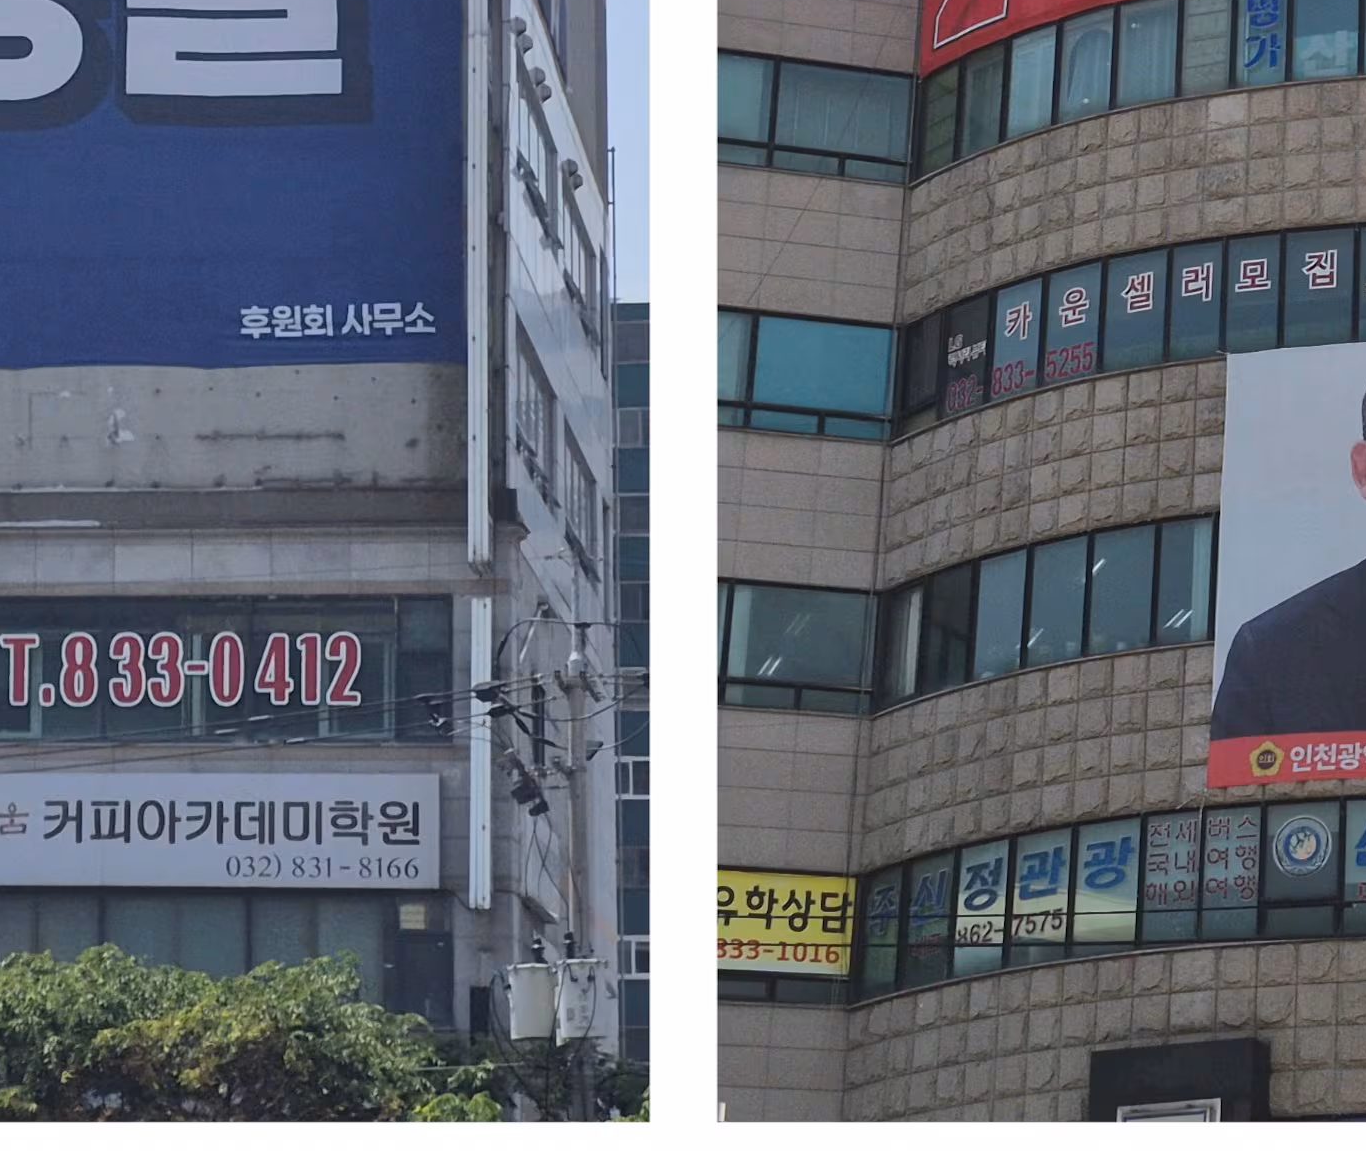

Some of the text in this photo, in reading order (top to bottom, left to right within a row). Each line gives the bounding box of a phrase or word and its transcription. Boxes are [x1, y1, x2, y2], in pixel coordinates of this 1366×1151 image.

[239, 303, 436, 339] 후원회 사무소
[43, 798, 422, 846] 커피아카데미학원
[225, 853, 283, 881] 032)
